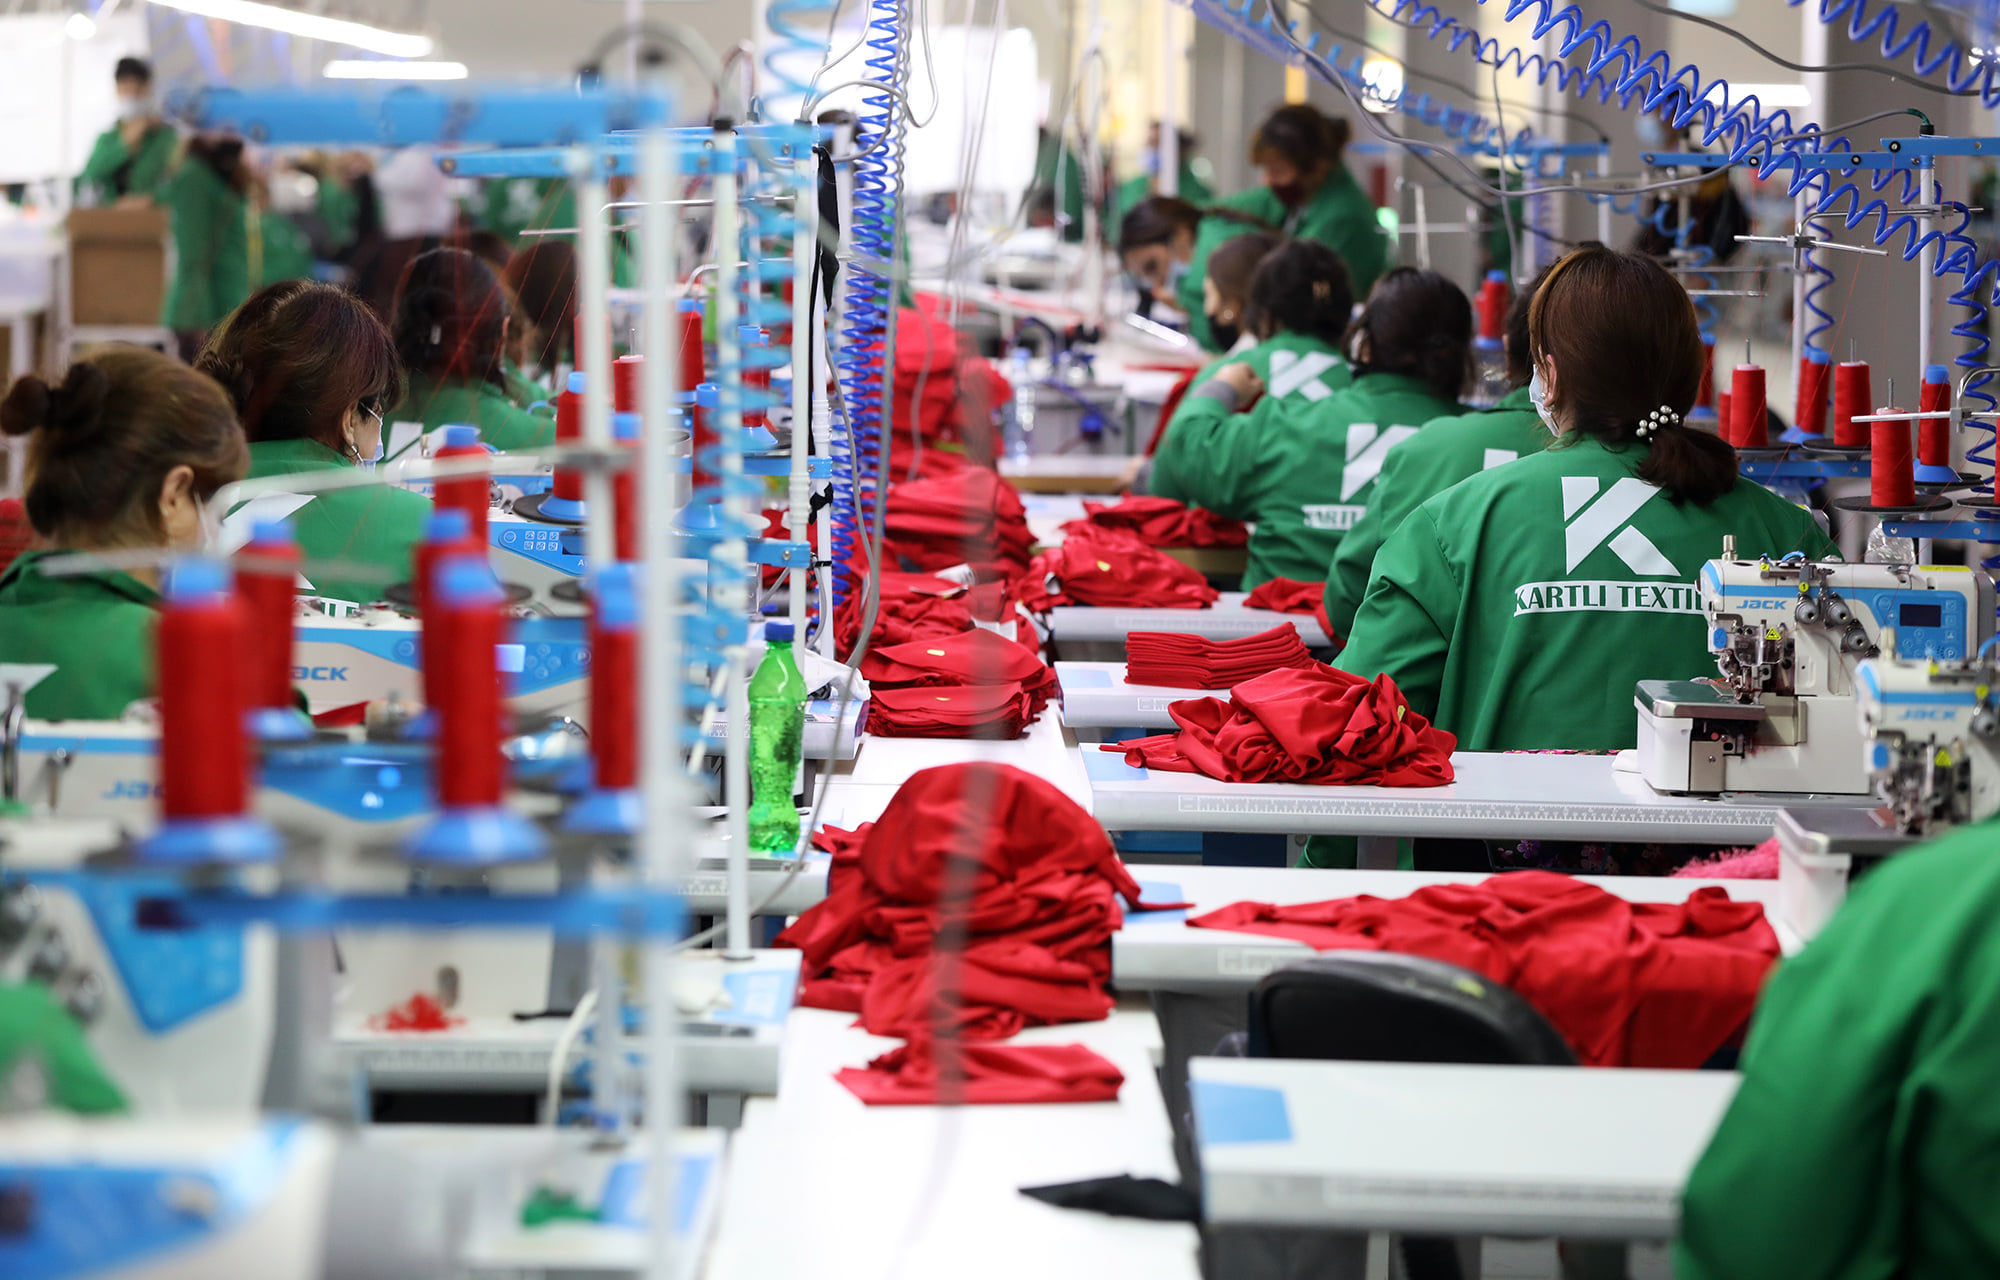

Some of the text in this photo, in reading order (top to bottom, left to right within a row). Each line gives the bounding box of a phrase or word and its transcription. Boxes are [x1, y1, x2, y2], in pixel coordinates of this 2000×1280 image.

[1516, 585, 1606, 610] KARTLI
[1736, 600, 1786, 610] JACK
[292, 666, 349, 681] ACK
